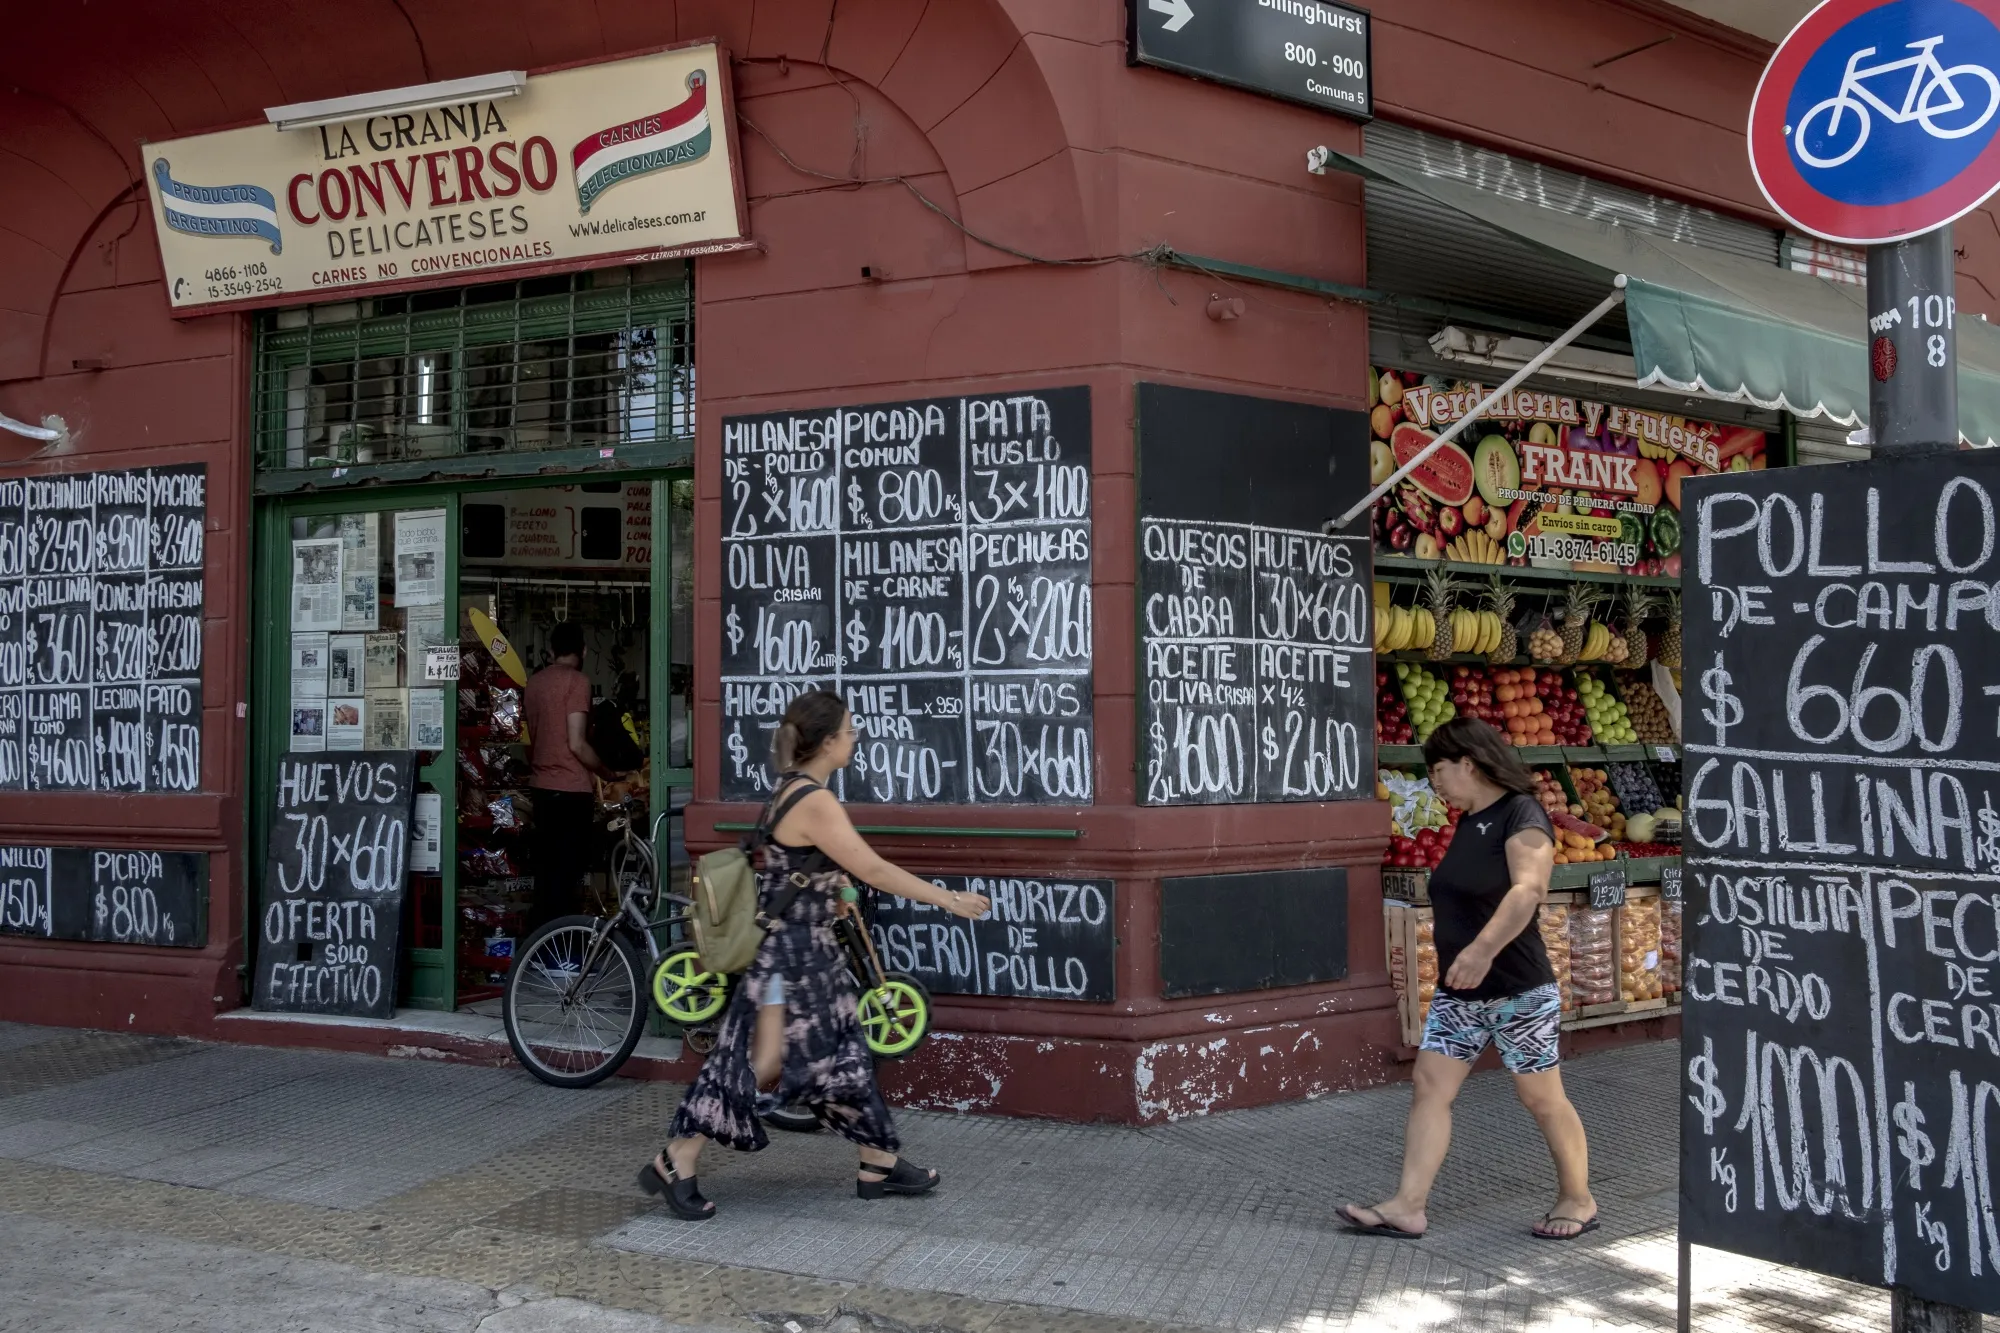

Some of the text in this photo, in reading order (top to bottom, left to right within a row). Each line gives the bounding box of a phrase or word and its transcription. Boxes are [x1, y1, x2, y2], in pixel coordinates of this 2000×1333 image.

[1284, 41, 1364, 80] 800 900
[1306, 78, 1365, 105] Comuna 5
[319, 100, 508, 161] LA GRANJA
[599, 116, 662, 148] CARNES
[286, 135, 559, 227] CONVERSO
[580, 140, 697, 203] SELECCIONADAS
[171, 182, 258, 203] PRODUCTOS
[168, 211, 260, 234] ARGENTINOS
[327, 204, 530, 260] DELICATESES
[204, 261, 268, 283] 4866-1108
[311, 240, 555, 286] CARNES NO CONVENCIONALES
[650, 250, 681, 261] LETRISTA
[207, 276, 284, 299] 15-3549-2542
[1926, 334, 1946, 368] 8
[844, 404, 945, 450] PICADA
[968, 395, 1051, 440] PATA
[1583, 400, 1603, 435] y
[724, 416, 838, 455] MILANESA
[971, 435, 1062, 466] MUSLO
[844, 446, 921, 469] COMUN
[1521, 443, 1639, 493] FRANK
[27, 476, 96, 511] COCHINILLO
[97, 472, 147, 505] RANAS
[151, 475, 206, 508] YACARE
[1498, 486, 1656, 515] PRODUCTOS DE PRIMERA CALIDAD
[945, 493, 962, 522] Kg
[1541, 515, 1618, 536] Envíos sin cargo
[1697, 475, 1996, 586] POLLO
[844, 533, 964, 578] MILANESA
[968, 527, 1089, 572] PECHUGAS
[1143, 524, 1247, 569] QUESOS
[1254, 531, 1355, 578] HUEVOS
[1528, 535, 1638, 567] 11-3874-6145
[728, 543, 811, 591] OLIVA
[1180, 564, 1206, 593] DE
[26, 576, 93, 609] GALLINA
[94, 580, 147, 612] CONEJO
[147, 575, 203, 609] FAISAN
[773, 587, 822, 602] CRISARI
[1007, 575, 1024, 602] Kg
[1146, 592, 1235, 638] CABRA
[947, 645, 963, 670] Kg
[1147, 644, 1238, 682] ACEITE
[1261, 644, 1351, 688] ACEITE
[28, 691, 82, 722] LLAMA
[93, 686, 142, 710] LECHON
[146, 685, 192, 716] PATO
[725, 681, 822, 717] HIGAD
[847, 684, 923, 716] MIEL
[935, 696, 963, 715] 950
[973, 678, 1081, 718] HUEVOS
[1149, 679, 1214, 705] OLIVA
[33, 720, 66, 736] LOMO
[852, 714, 915, 741] PURA
[277, 760, 398, 809] HUEVOS
[1688, 755, 1977, 871] GALLINA
[94, 850, 164, 885] PICADA
[264, 898, 377, 945] OFERTA
[1877, 878, 2000, 963] PEC
[324, 943, 369, 966] SOLO
[1008, 925, 1039, 954] DE
[1737, 923, 1794, 966] DE
[269, 961, 382, 1008] EFECTIVO
[986, 951, 1088, 996] POLLO
[1686, 955, 1832, 1025] CERDO
[1944, 960, 1993, 1001] DE
[1886, 991, 2000, 1058] CER
[1709, 1145, 1738, 1214] Kg
[1914, 1200, 1951, 1272] Kg
